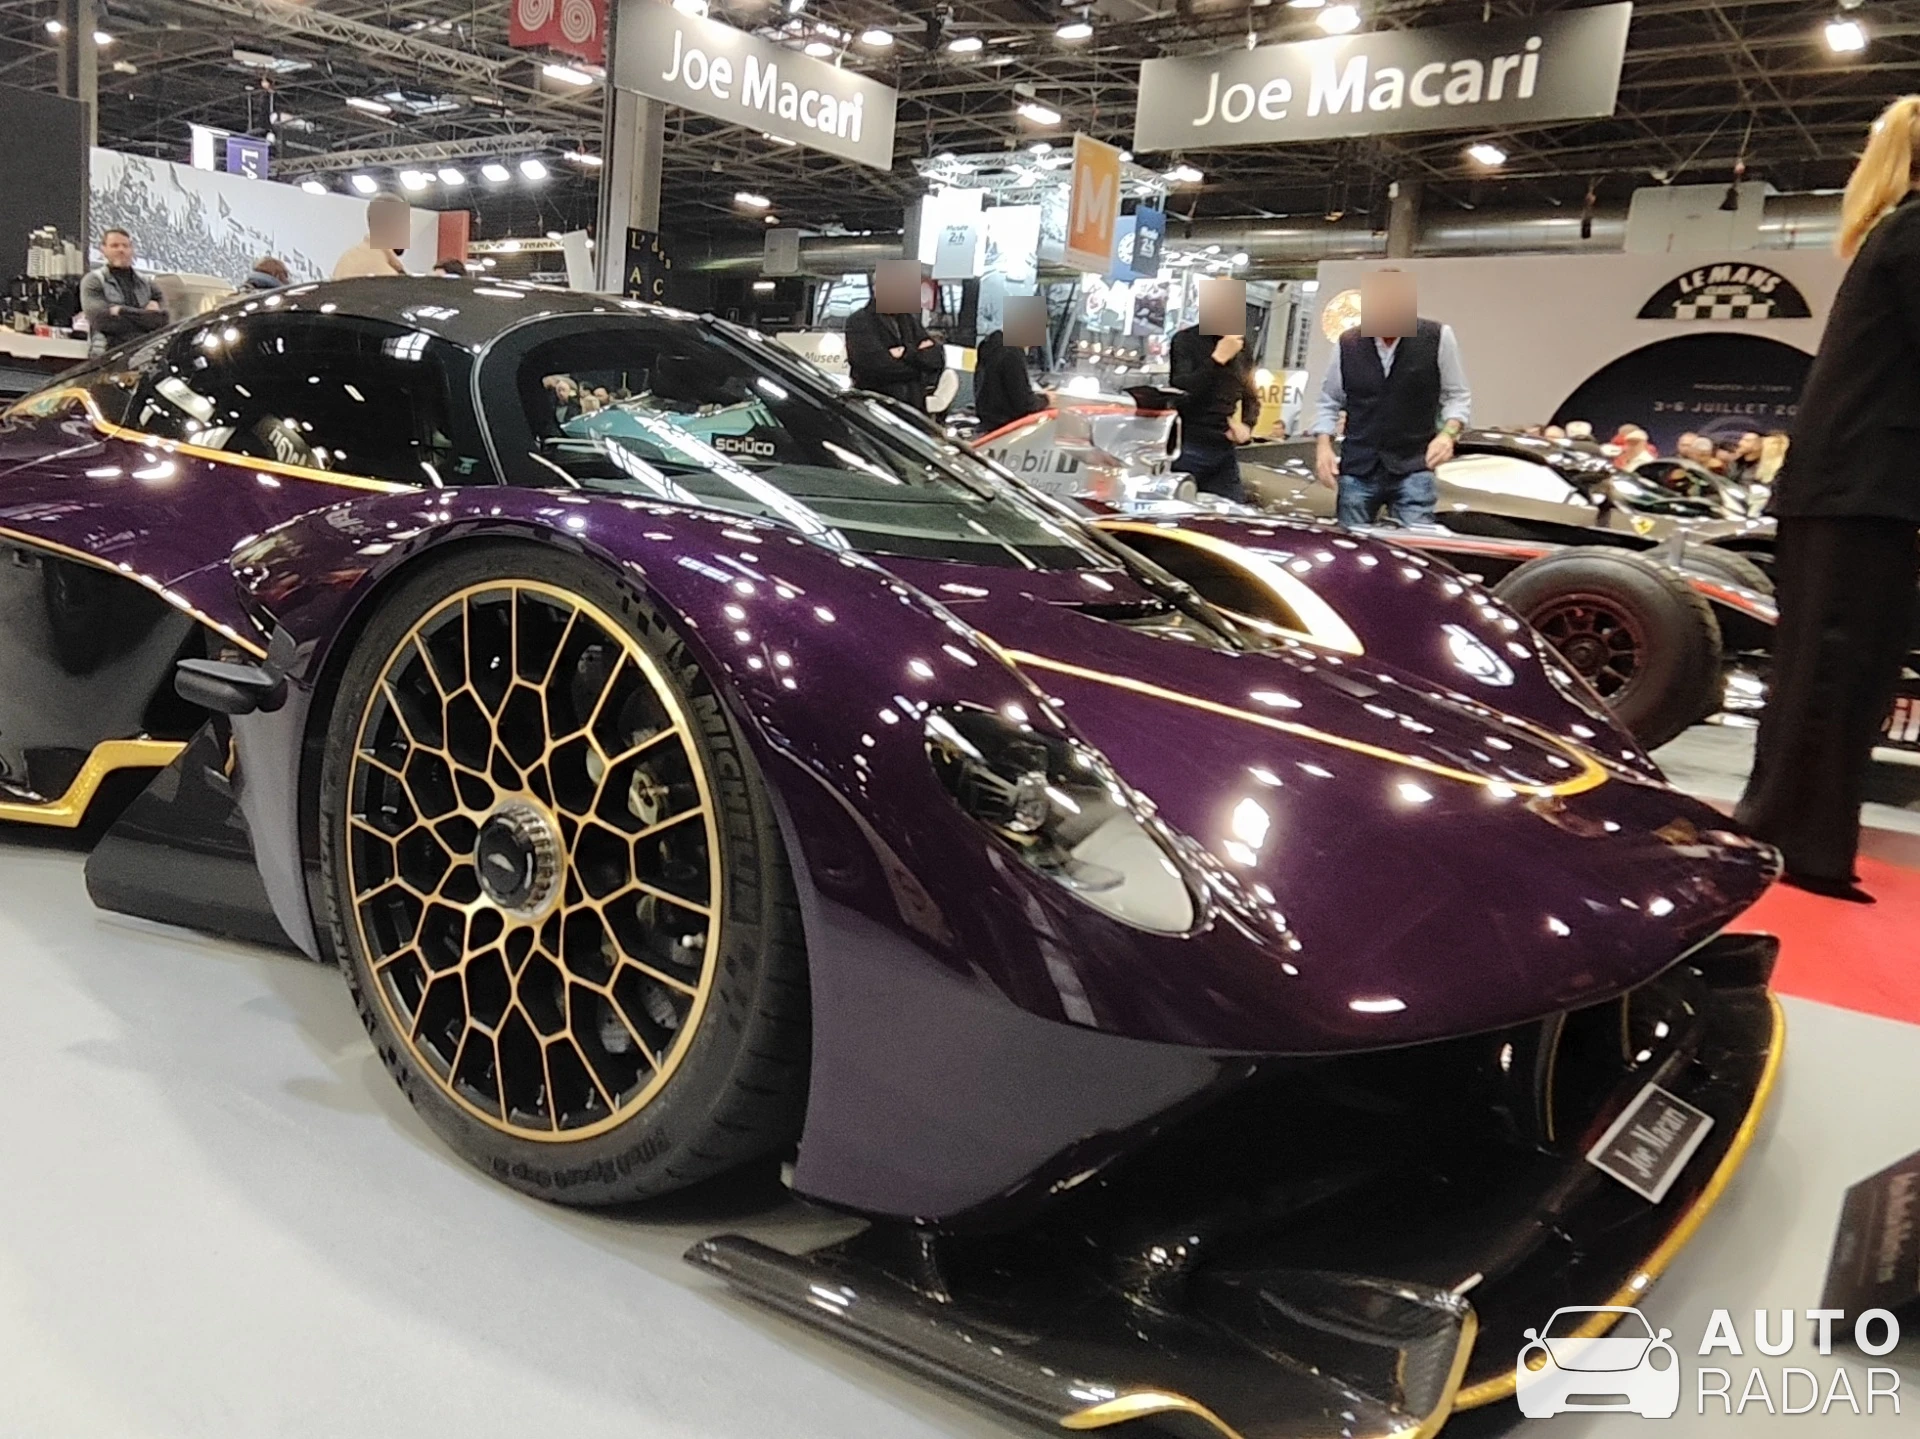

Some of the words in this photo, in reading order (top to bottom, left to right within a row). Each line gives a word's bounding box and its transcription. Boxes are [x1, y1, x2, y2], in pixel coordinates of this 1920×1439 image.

[662, 30, 733, 99] Joe
[741, 54, 864, 142] Macari
[1193, 72, 1292, 126] Joe
[1306, 36, 1542, 117] Macari
[1076, 164, 1113, 240] M
[1679, 270, 1706, 294] LE
[1707, 265, 1781, 293] MANS
[1691, 402, 1768, 414] JUILLET
[988, 448, 1054, 473] Mobil
[691, 694, 761, 922] MICHELIN
[1629, 1100, 1689, 1155] Macari
[1614, 1145, 1660, 1179] Joe
